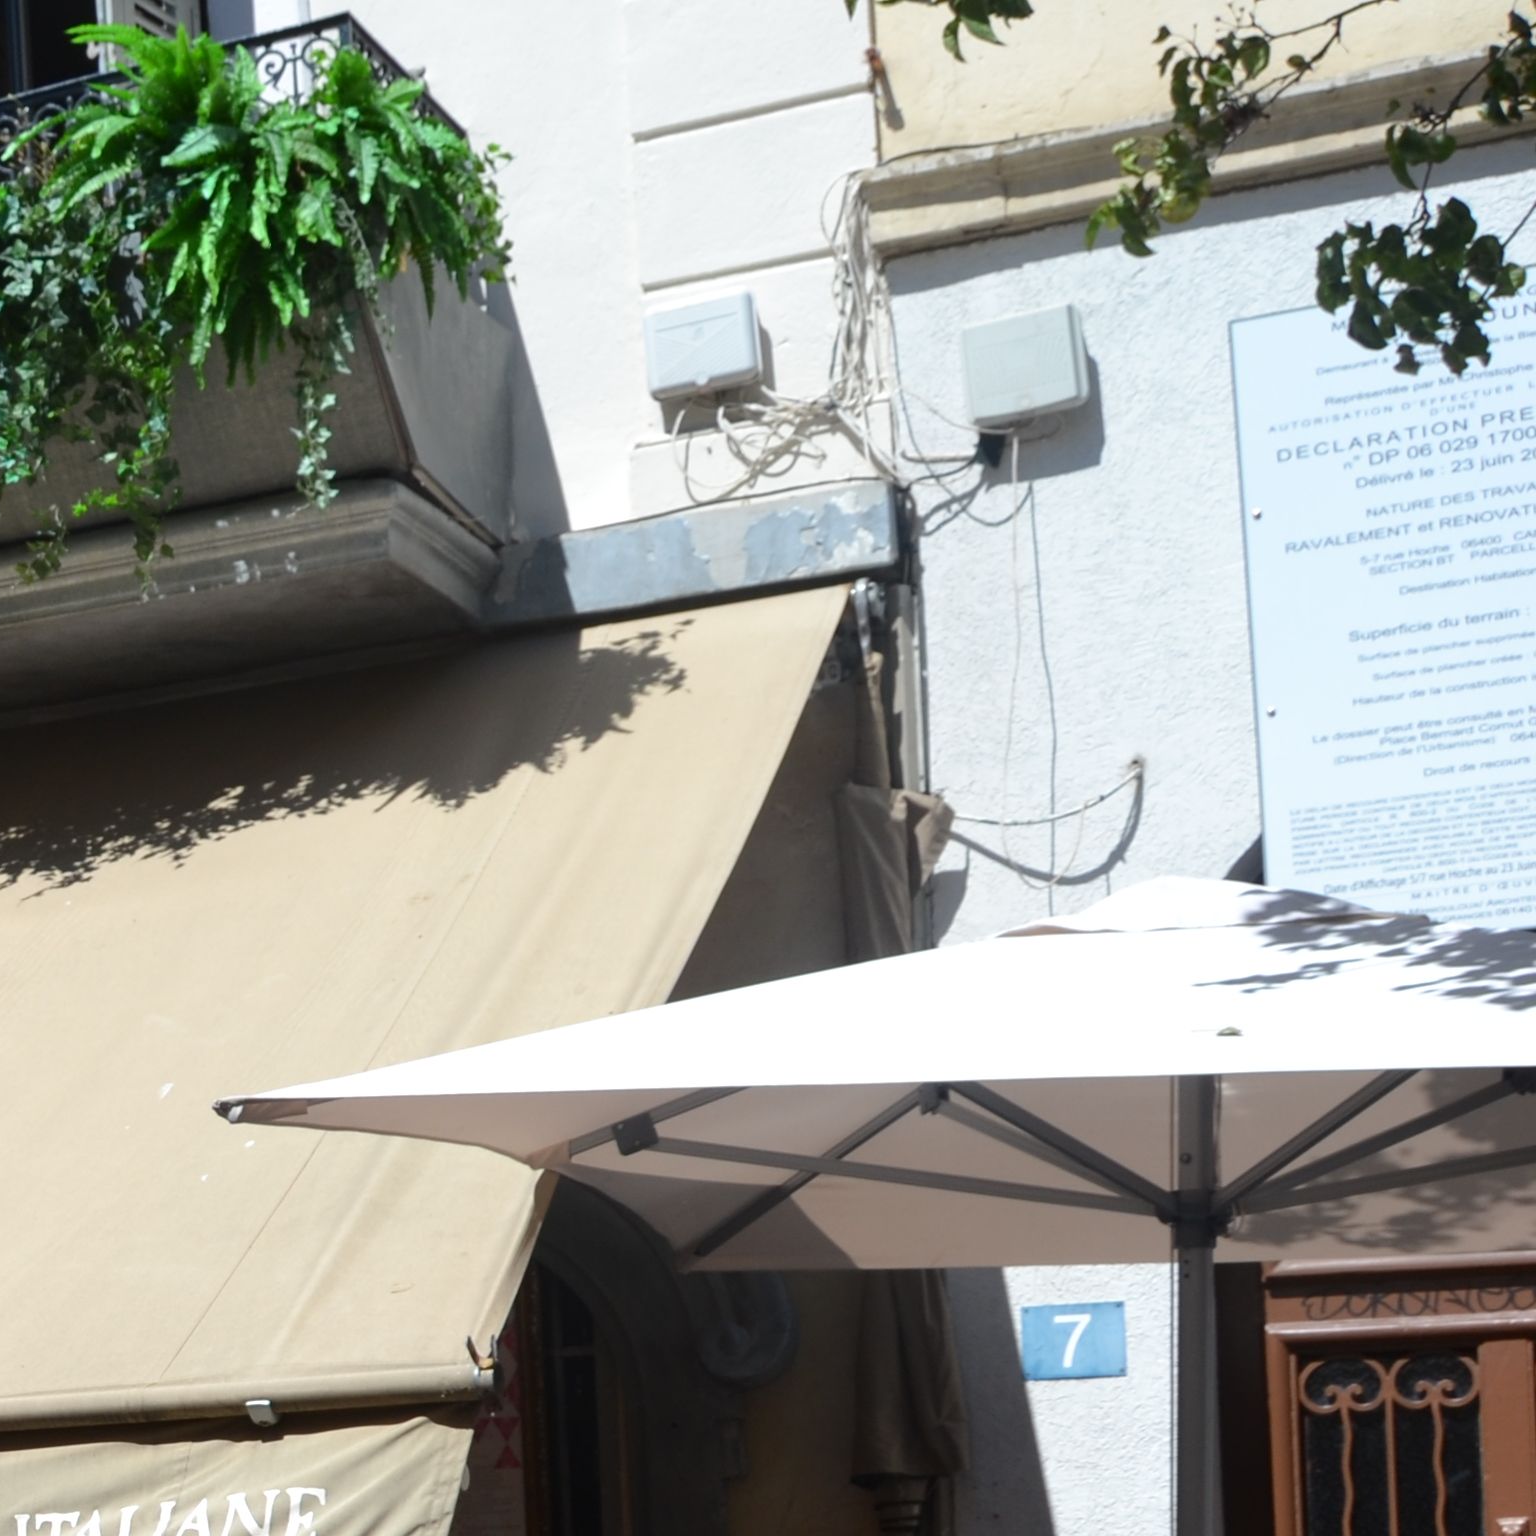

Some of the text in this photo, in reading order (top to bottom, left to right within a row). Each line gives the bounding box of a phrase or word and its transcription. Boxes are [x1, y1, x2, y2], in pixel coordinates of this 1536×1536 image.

[1324, 383, 1409, 406] Représentée
[1458, 363, 1534, 384] Christophe
[1268, 402, 1394, 433] AUTORISATION
[1276, 405, 1535, 464] DECLARATION PRE
[1368, 448, 1400, 468] DP
[1406, 442, 1434, 460] 06
[1438, 434, 1479, 454] 029
[1487, 424, 1536, 445] 1700
[1355, 469, 1415, 490] Délivré
[1419, 466, 1435, 478] le
[1451, 460, 1475, 475] 23
[1479, 452, 1515, 472] juin
[1365, 496, 1436, 519] NATURE
[1439, 491, 1476, 508] DES
[1284, 522, 1413, 556] RAVALEMENT
[1416, 520, 1434, 534] et
[1408, 543, 1451, 559] Hoche
[1368, 557, 1434, 578] SECTION
[1398, 576, 1471, 597] Destination
[1348, 620, 1433, 644] Superficie
[1437, 614, 1460, 630] du
[1464, 607, 1521, 626] terrain
[1445, 673, 1528, 695] construction
[1422, 755, 1532, 778] Droit de recours
[1052, 1313, 1092, 1369] 7
